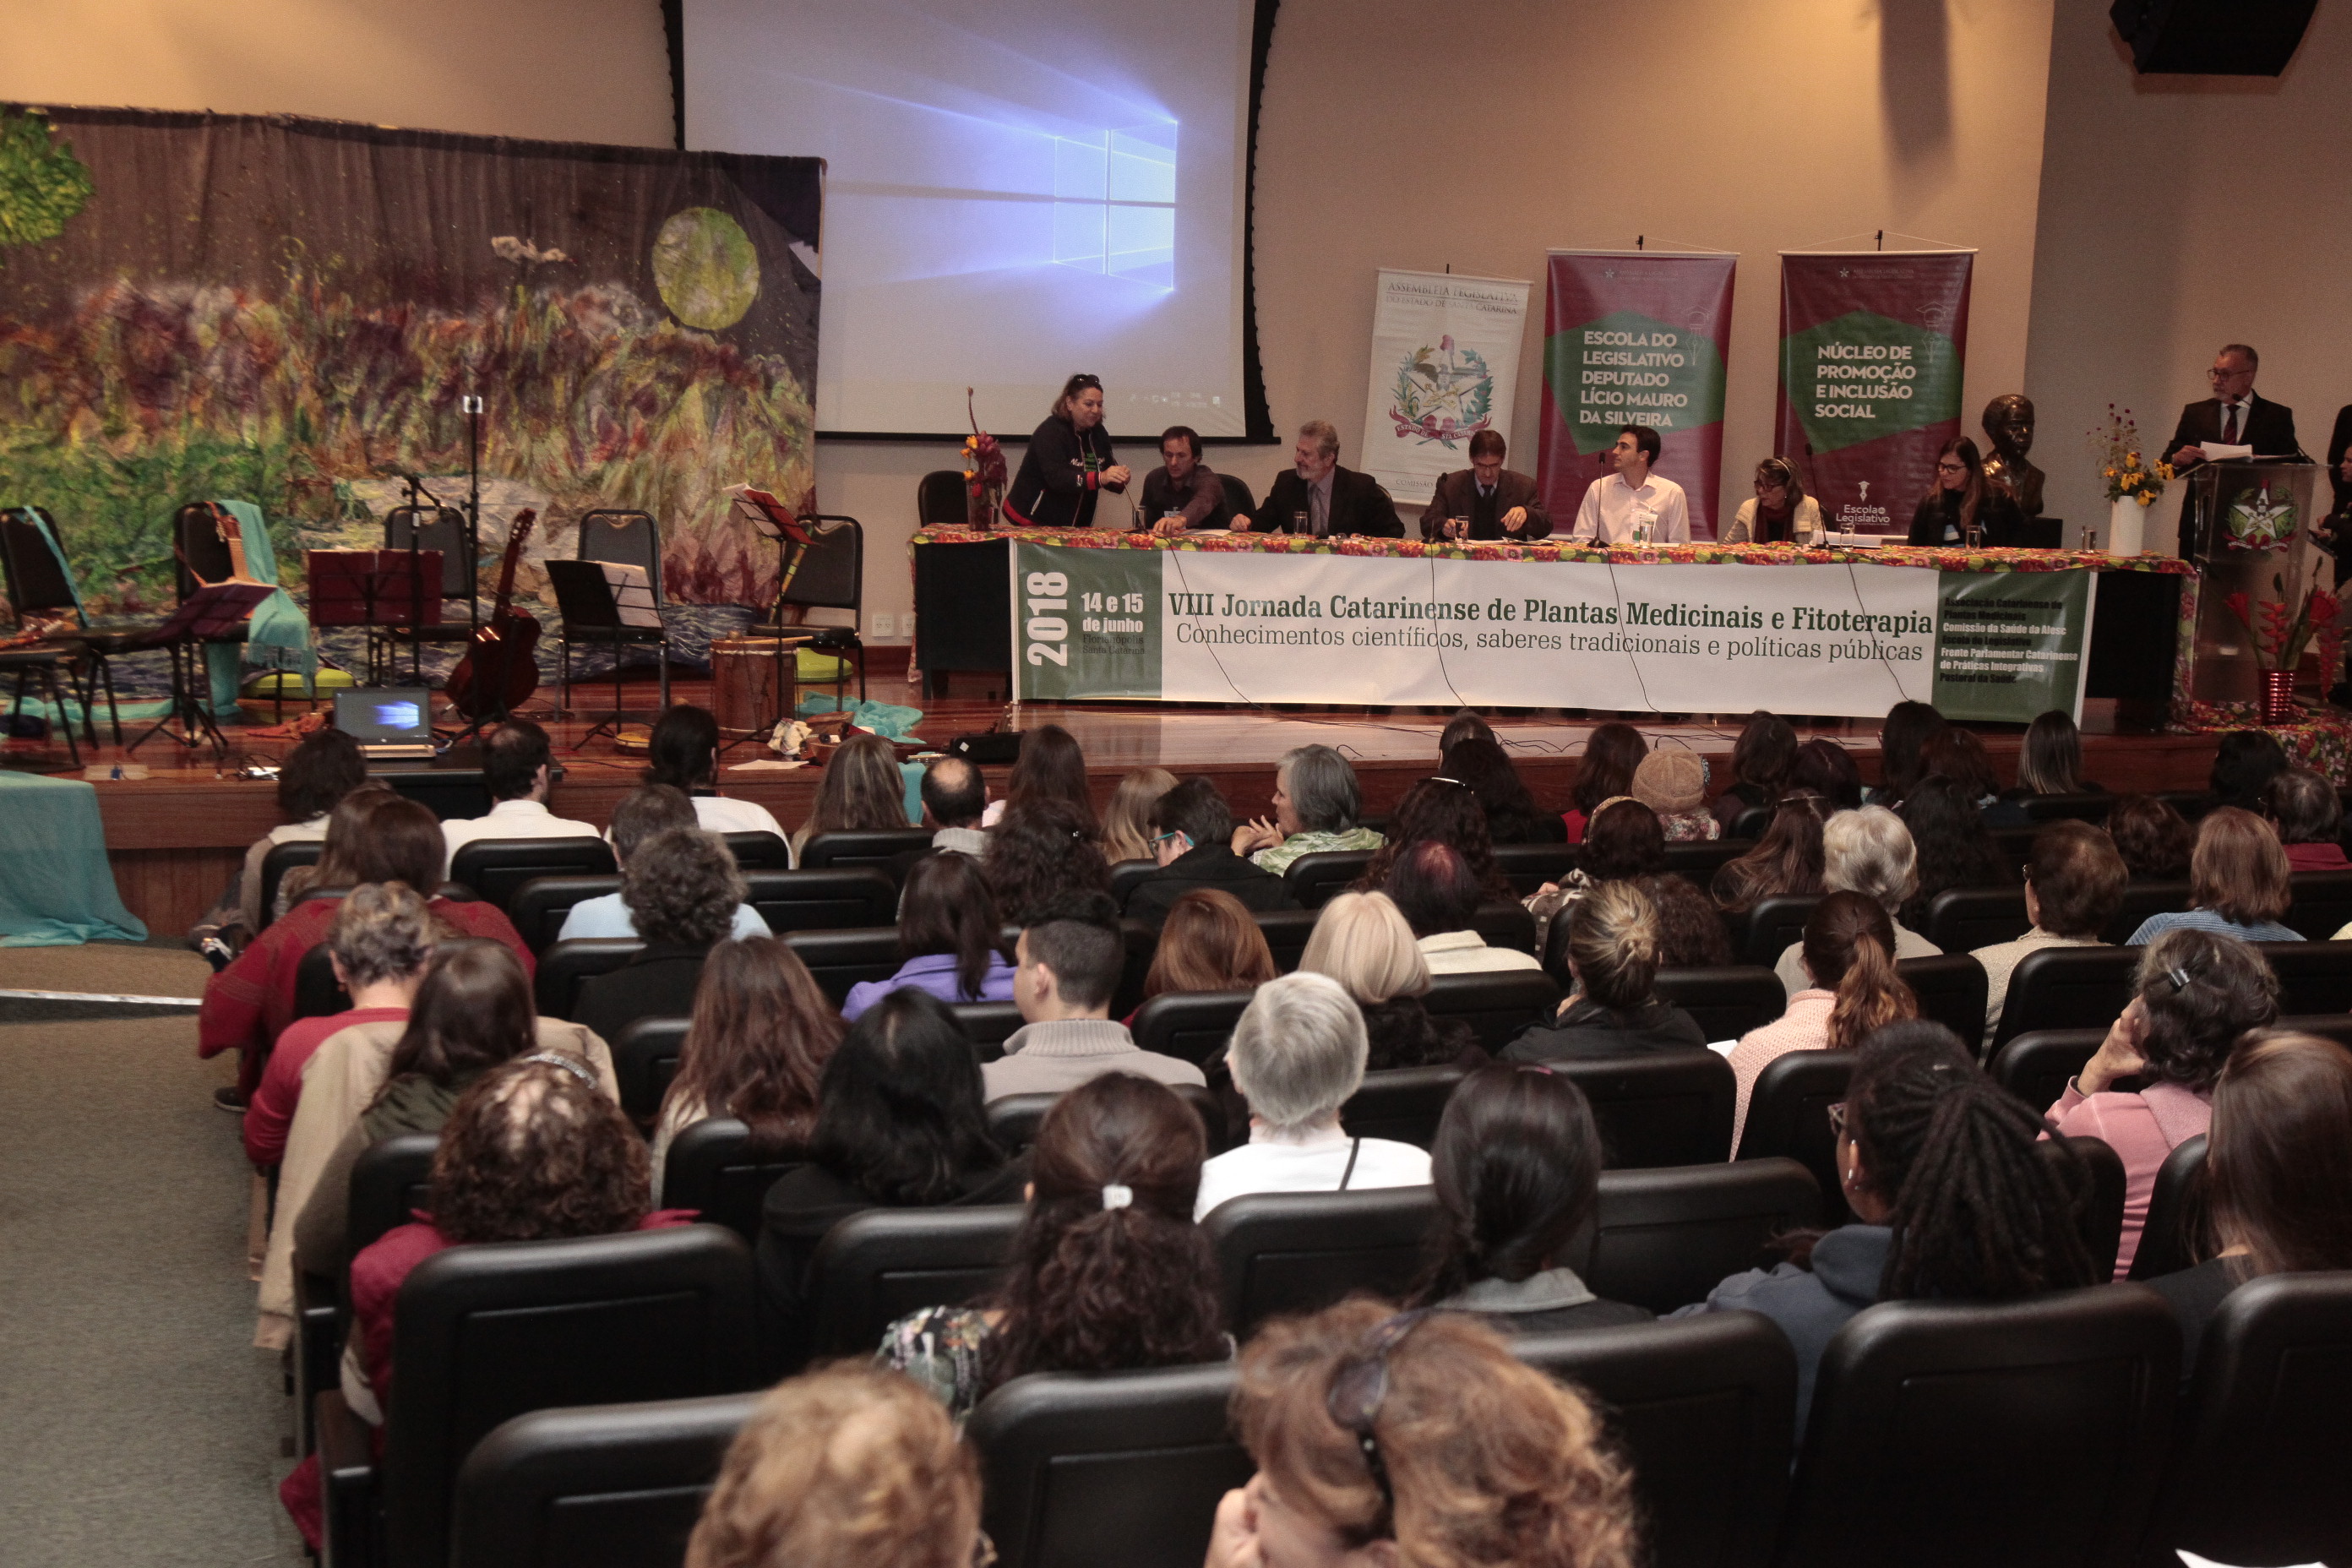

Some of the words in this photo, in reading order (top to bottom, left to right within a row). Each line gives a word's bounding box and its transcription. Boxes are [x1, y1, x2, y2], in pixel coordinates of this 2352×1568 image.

[1388, 282, 1449, 297] ASSEMBLEIA
[1453, 287, 1518, 302] LEGISLATIVA
[1476, 304, 1517, 314] CATARINA
[1584, 330, 1648, 346] ESCOLA
[1651, 333, 1677, 347] DO
[1817, 341, 1887, 360] NÚCLEO
[1889, 346, 1913, 360] DE
[1582, 351, 1685, 368] LEGISLATIVO
[1582, 370, 1669, 387] DEPUTADO
[1816, 362, 1917, 384] PROMOÇÃO
[1581, 386, 1625, 406] LÍCIO
[1625, 392, 1688, 407] MAURO
[1816, 384, 1827, 398] E
[1829, 381, 1914, 400] INCLUSÃO
[1579, 410, 1602, 424] DA
[1603, 411, 1673, 427] SILVEIRA
[1814, 404, 1876, 418] SOCIAL
[1396, 479, 1435, 488] COMISSÃO
[1843, 504, 1878, 514] Escola
[1836, 513, 1891, 524] Legislativo
[1081, 592, 1102, 612] 14
[1106, 596, 1119, 612] e
[1122, 593, 1144, 613] 15
[1026, 572, 1068, 667] 2018
[1168, 592, 1214, 616] VIII
[1222, 593, 1322, 618] Jornada
[1330, 594, 1479, 620] Catarinense
[1487, 597, 1516, 622] de
[1523, 598, 1618, 625] Plantas
[1625, 602, 1763, 629] Medicinais
[1771, 611, 1785, 630] e
[1791, 607, 1933, 639] Fitoterapia
[1944, 610, 1977, 619] Plantas
[1978, 611, 2026, 621] Medicinais
[1082, 617, 1101, 632] de
[1102, 618, 1144, 634] junho
[1943, 622, 1986, 633] Comissão
[1987, 624, 1999, 634] da
[2000, 623, 2028, 634] Saúde
[2028, 625, 2040, 634] da
[2041, 625, 2067, 635] Alesc
[1176, 623, 1345, 646] Conhecimentos
[1352, 625, 1468, 651] científicos,
[1476, 628, 1562, 651] saberes
[1570, 631, 1701, 656] tradicionais
[1707, 639, 1720, 656] e
[1726, 635, 1821, 661] políticas
[1827, 638, 1923, 663] públicas
[1942, 635, 1970, 645] Escola
[1984, 637, 2032, 646] Legislativo
[1082, 645, 1107, 655] Santa
[1108, 645, 1145, 655] Catarina
[1941, 647, 1969, 657] Frente
[1970, 648, 2025, 659] Parlamentar
[2025, 650, 2078, 661] Catarinense
[1940, 660, 1952, 670] de
[1952, 661, 1990, 671] Práticas
[1990, 662, 2044, 672] Integrativas
[1940, 672, 1976, 683] Pastoral
[1977, 674, 1989, 683] da
